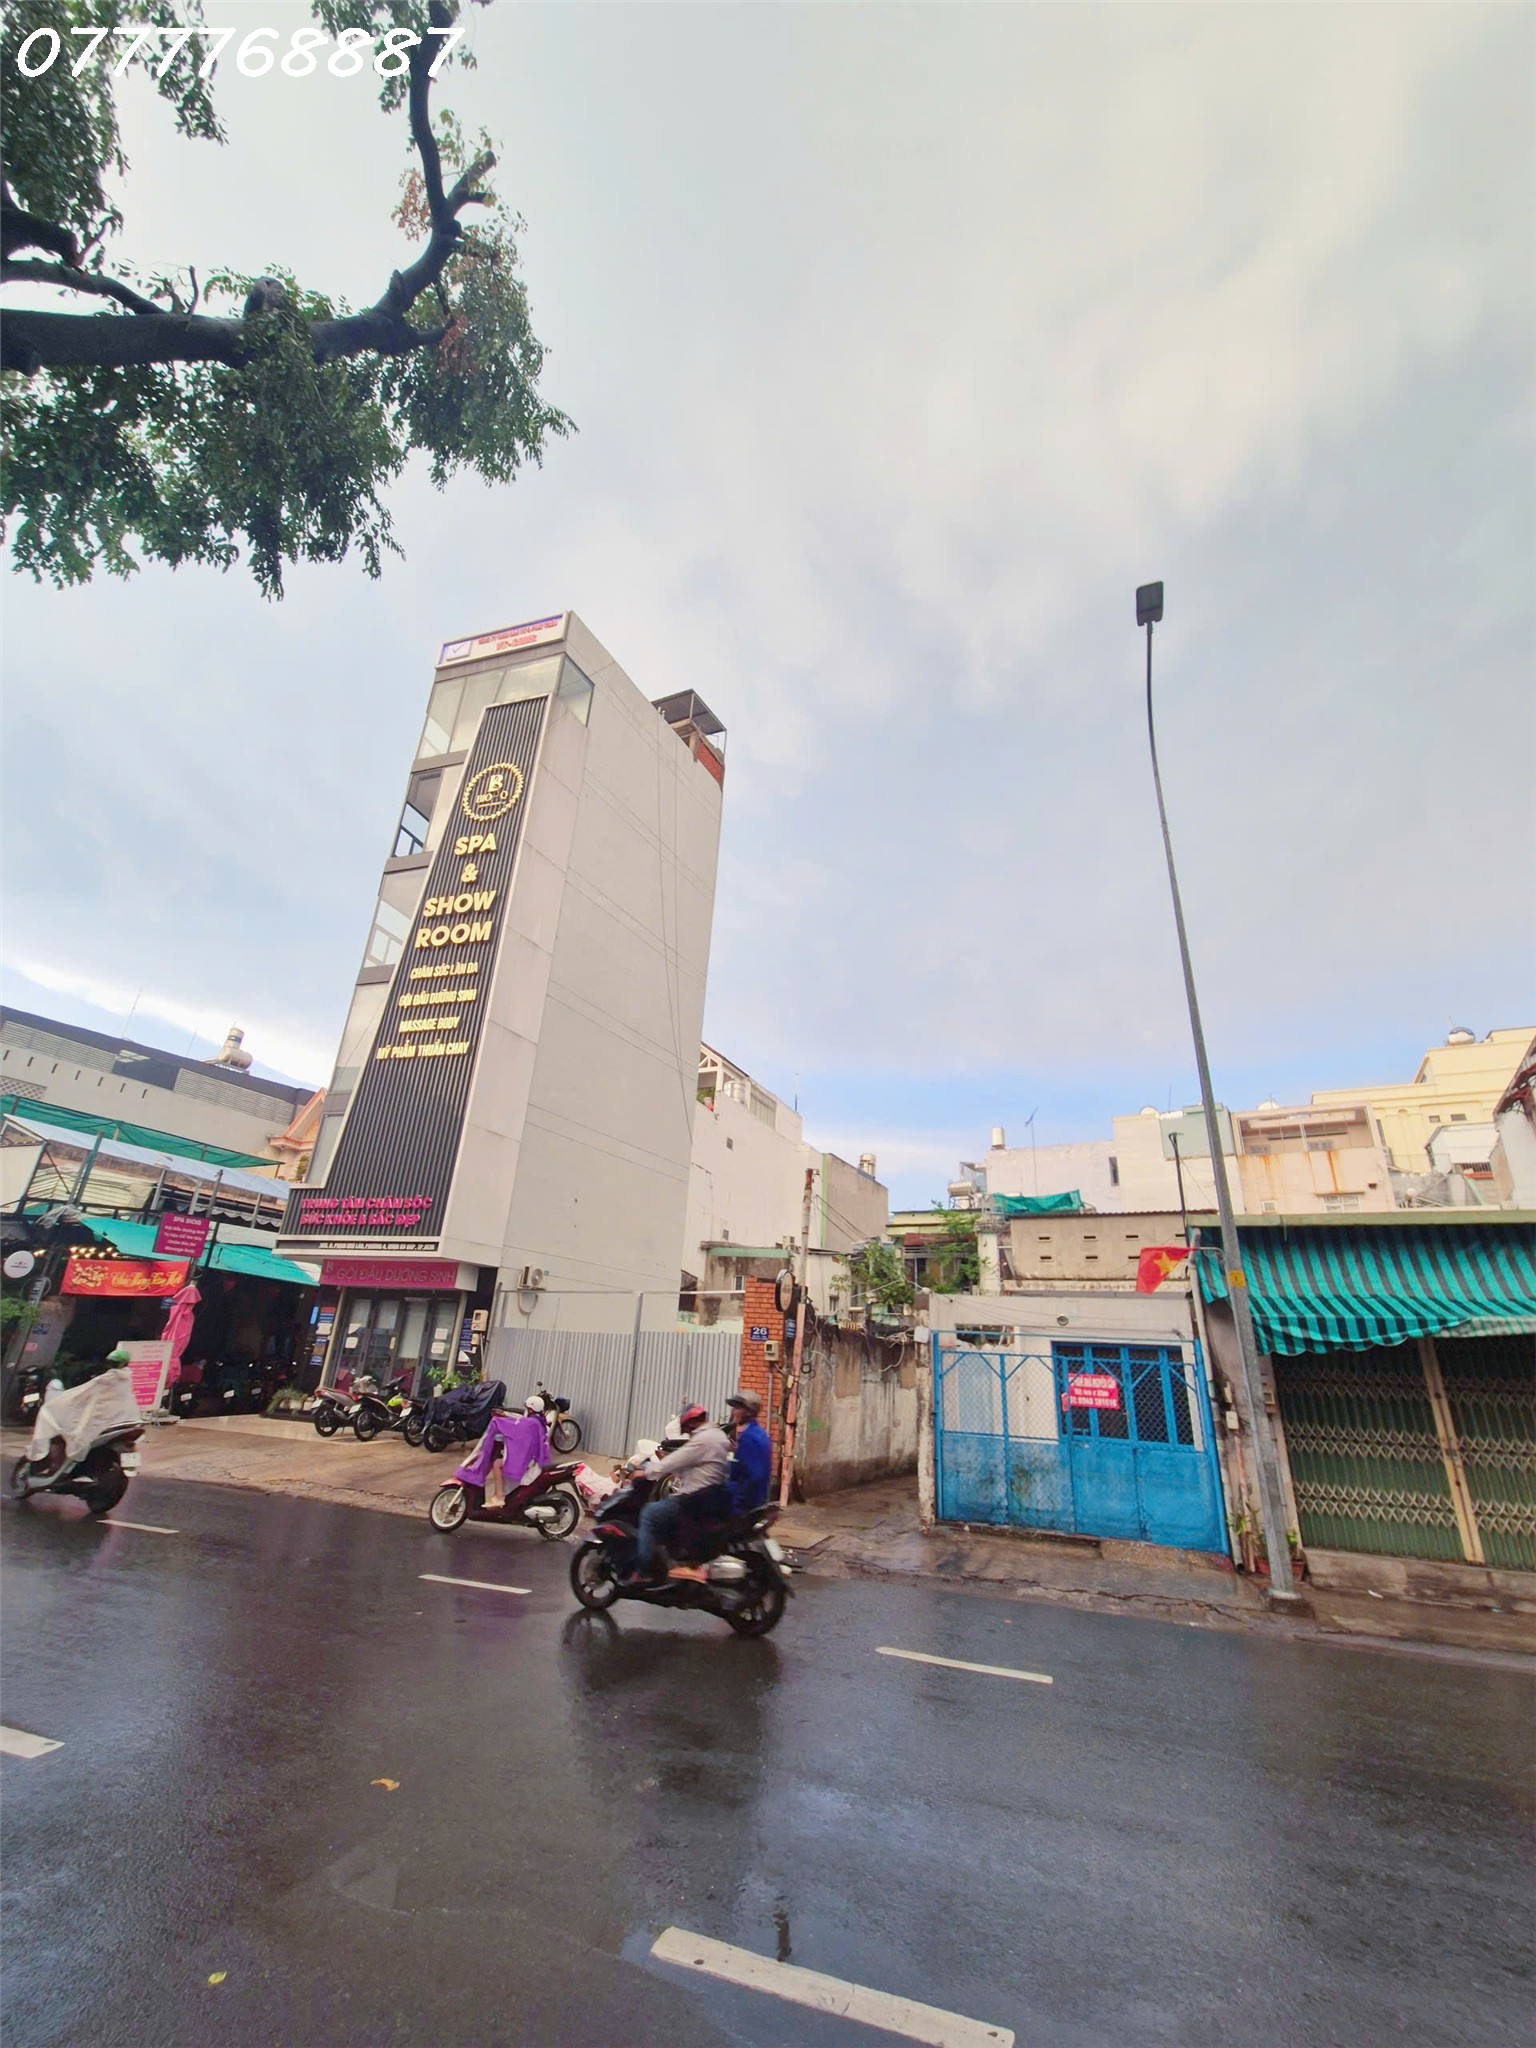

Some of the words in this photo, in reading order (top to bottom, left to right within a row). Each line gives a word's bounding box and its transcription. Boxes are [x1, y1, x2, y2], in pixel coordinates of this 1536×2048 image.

[454, 833, 496, 856] SPA
[461, 863, 478, 883] &
[423, 890, 496, 917] SHOW
[415, 921, 492, 948] ROOM
[433, 963, 450, 977] SÓC
[466, 962, 478, 974] DA
[457, 989, 477, 1002] SINH
[399, 1018, 438, 1033] MASSAGE
[437, 1016, 460, 1029] BODY
[446, 1042, 469, 1055] CHAY
[301, 1198, 339, 1209] TRUNG
[341, 1195, 365, 1209] TÂM
[403, 1194, 433, 1209] SÓC
[430, 1270, 456, 1283] SINH
[752, 1327, 767, 1335] 26
